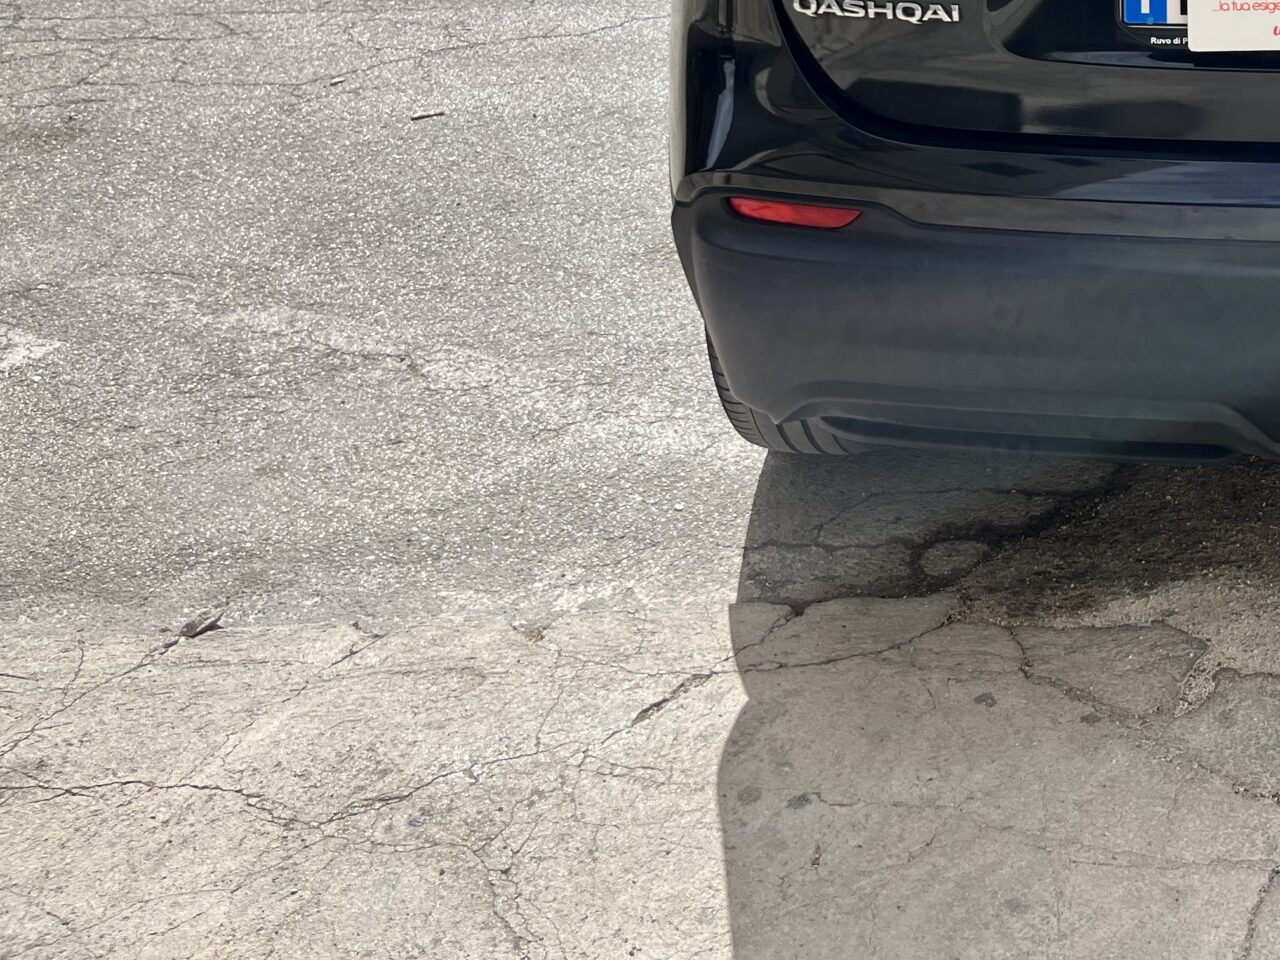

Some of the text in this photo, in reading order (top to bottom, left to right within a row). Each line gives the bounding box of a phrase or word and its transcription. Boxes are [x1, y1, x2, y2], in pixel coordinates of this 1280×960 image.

[1231, 0, 1250, 12] tua
[1150, 36, 1172, 45] Ruvo
[1172, 36, 1181, 45] di
